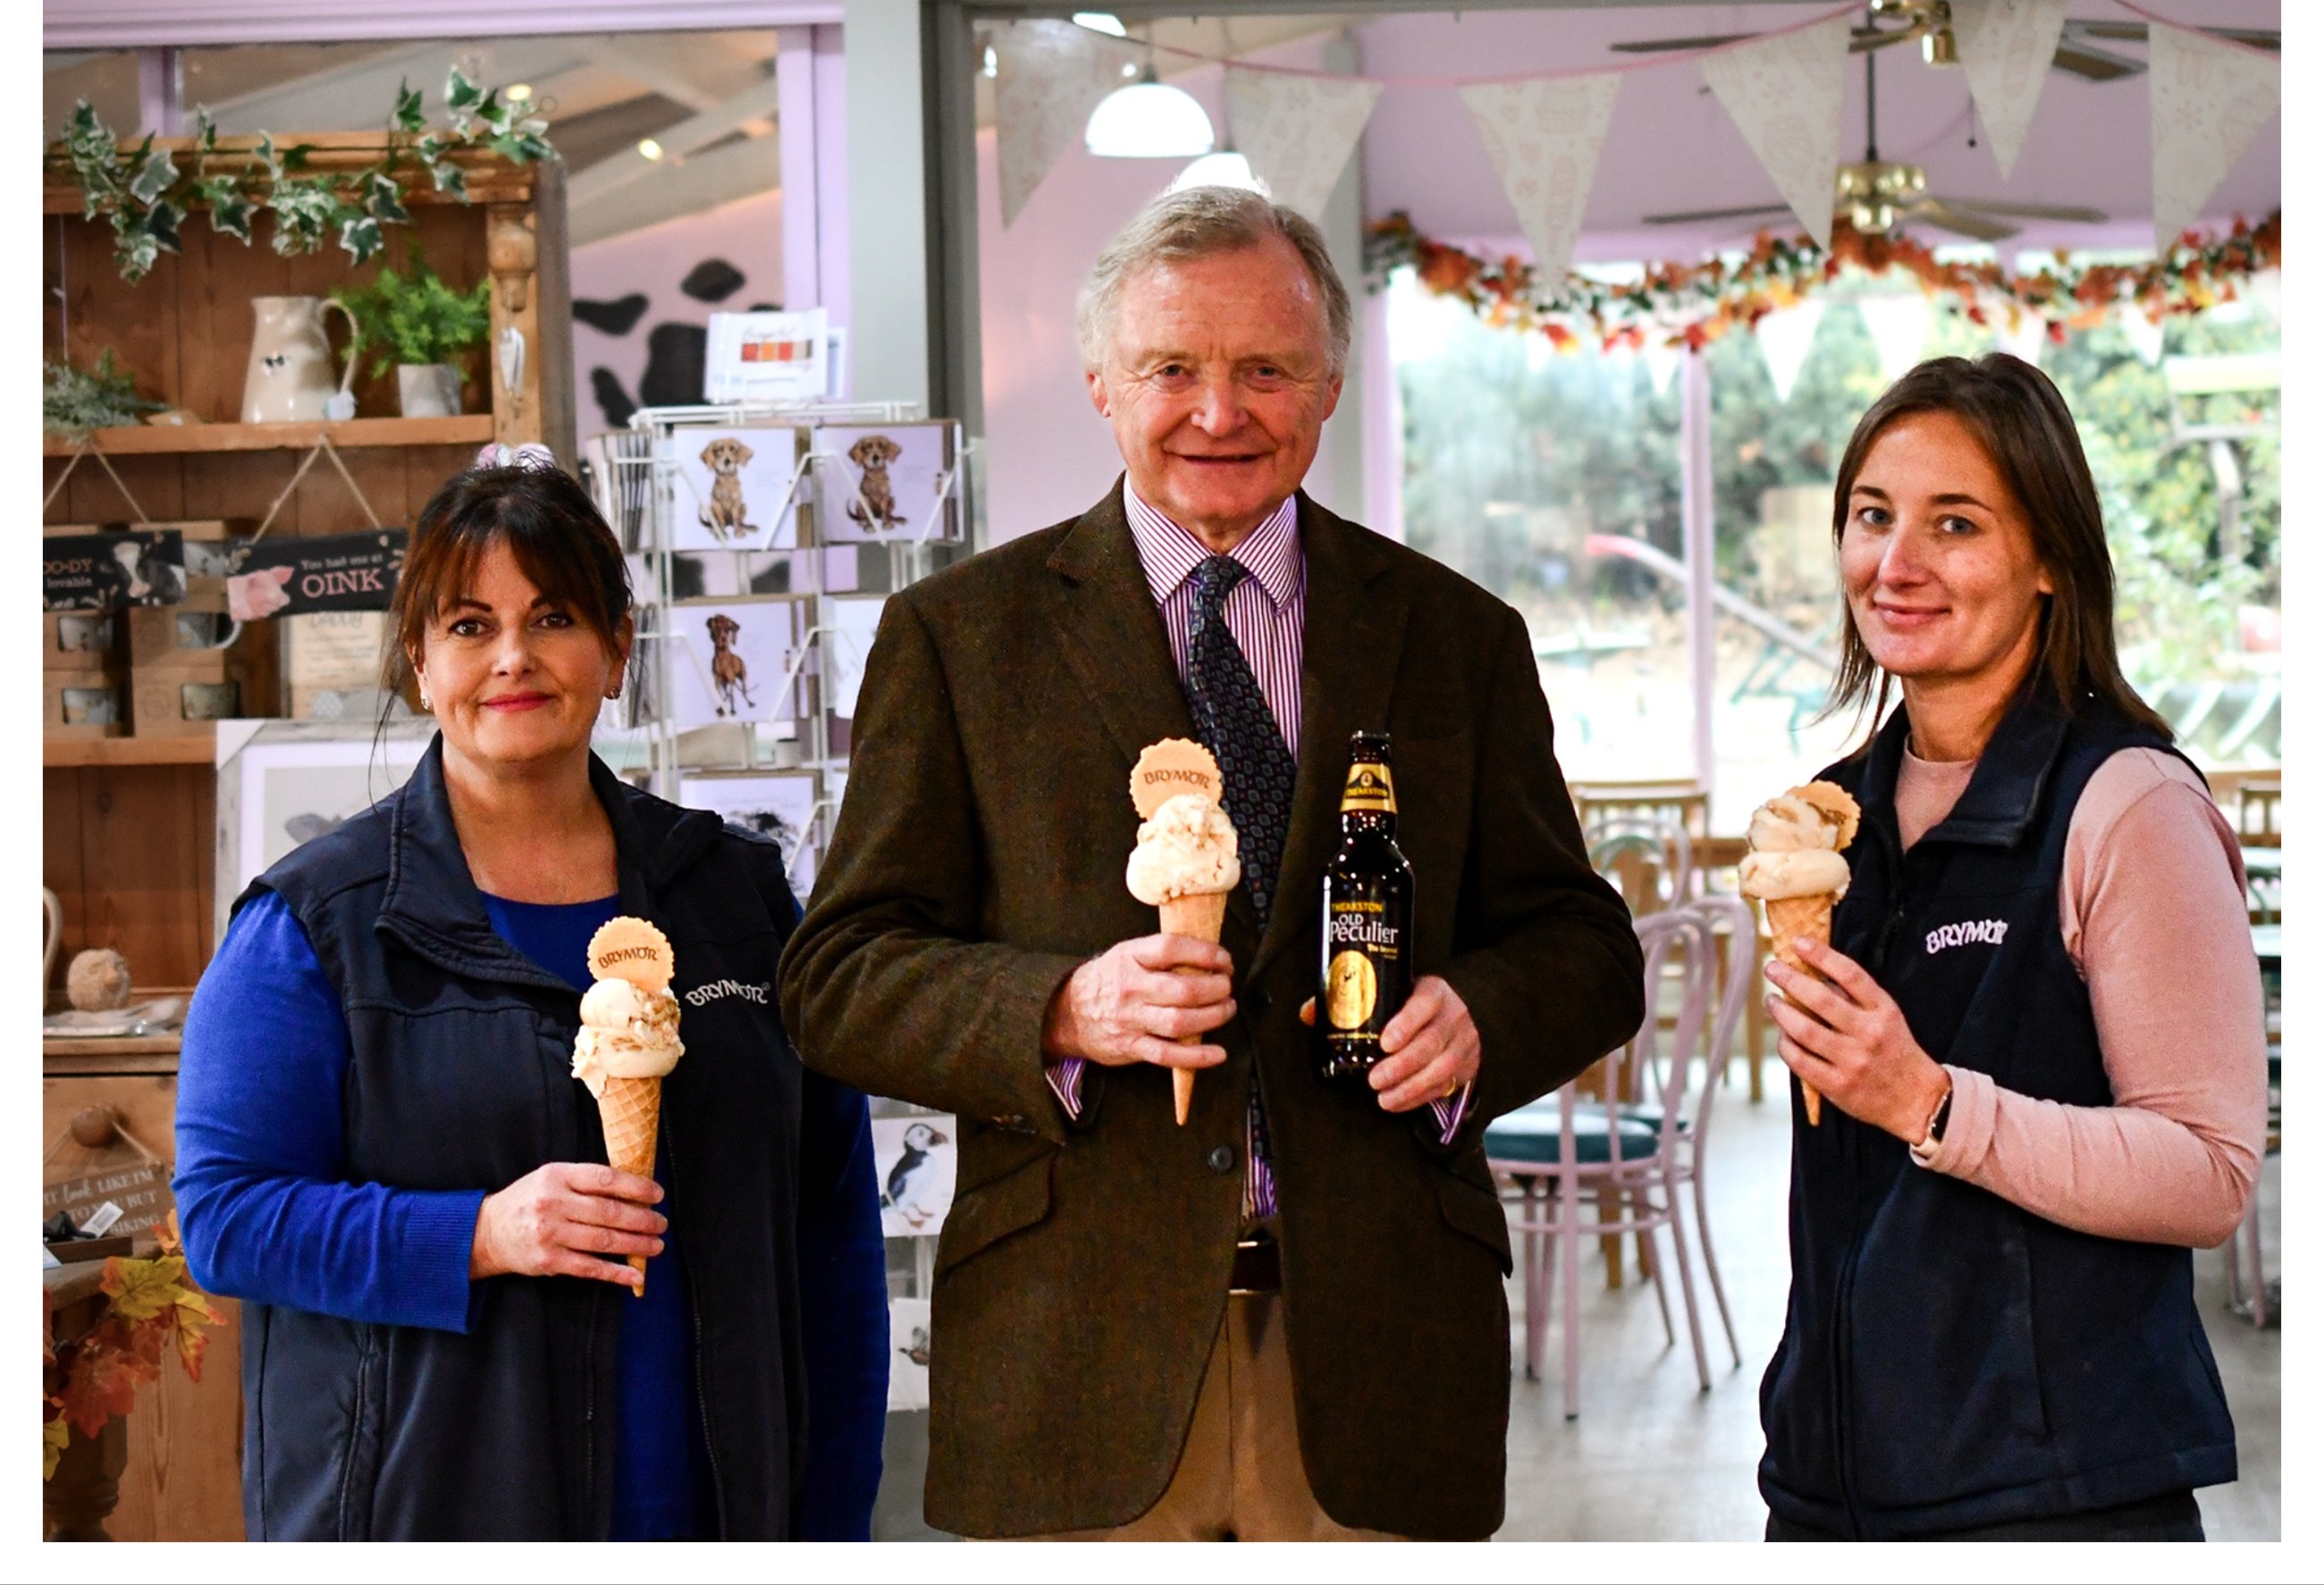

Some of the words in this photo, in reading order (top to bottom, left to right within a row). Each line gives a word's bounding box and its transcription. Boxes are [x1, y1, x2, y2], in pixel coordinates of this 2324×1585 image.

[301, 558, 323, 570] You
[325, 556, 348, 568] had
[301, 567, 385, 599] OINK
[1143, 769, 1210, 789] BRYMOR
[1338, 913, 1364, 926] OLD
[1329, 921, 1399, 944] Peculier
[598, 945, 659, 969] BRYMOR
[97, 1175, 131, 1194] LIKE
[68, 1205, 91, 1222] TO
[126, 1190, 156, 1209] BUT
